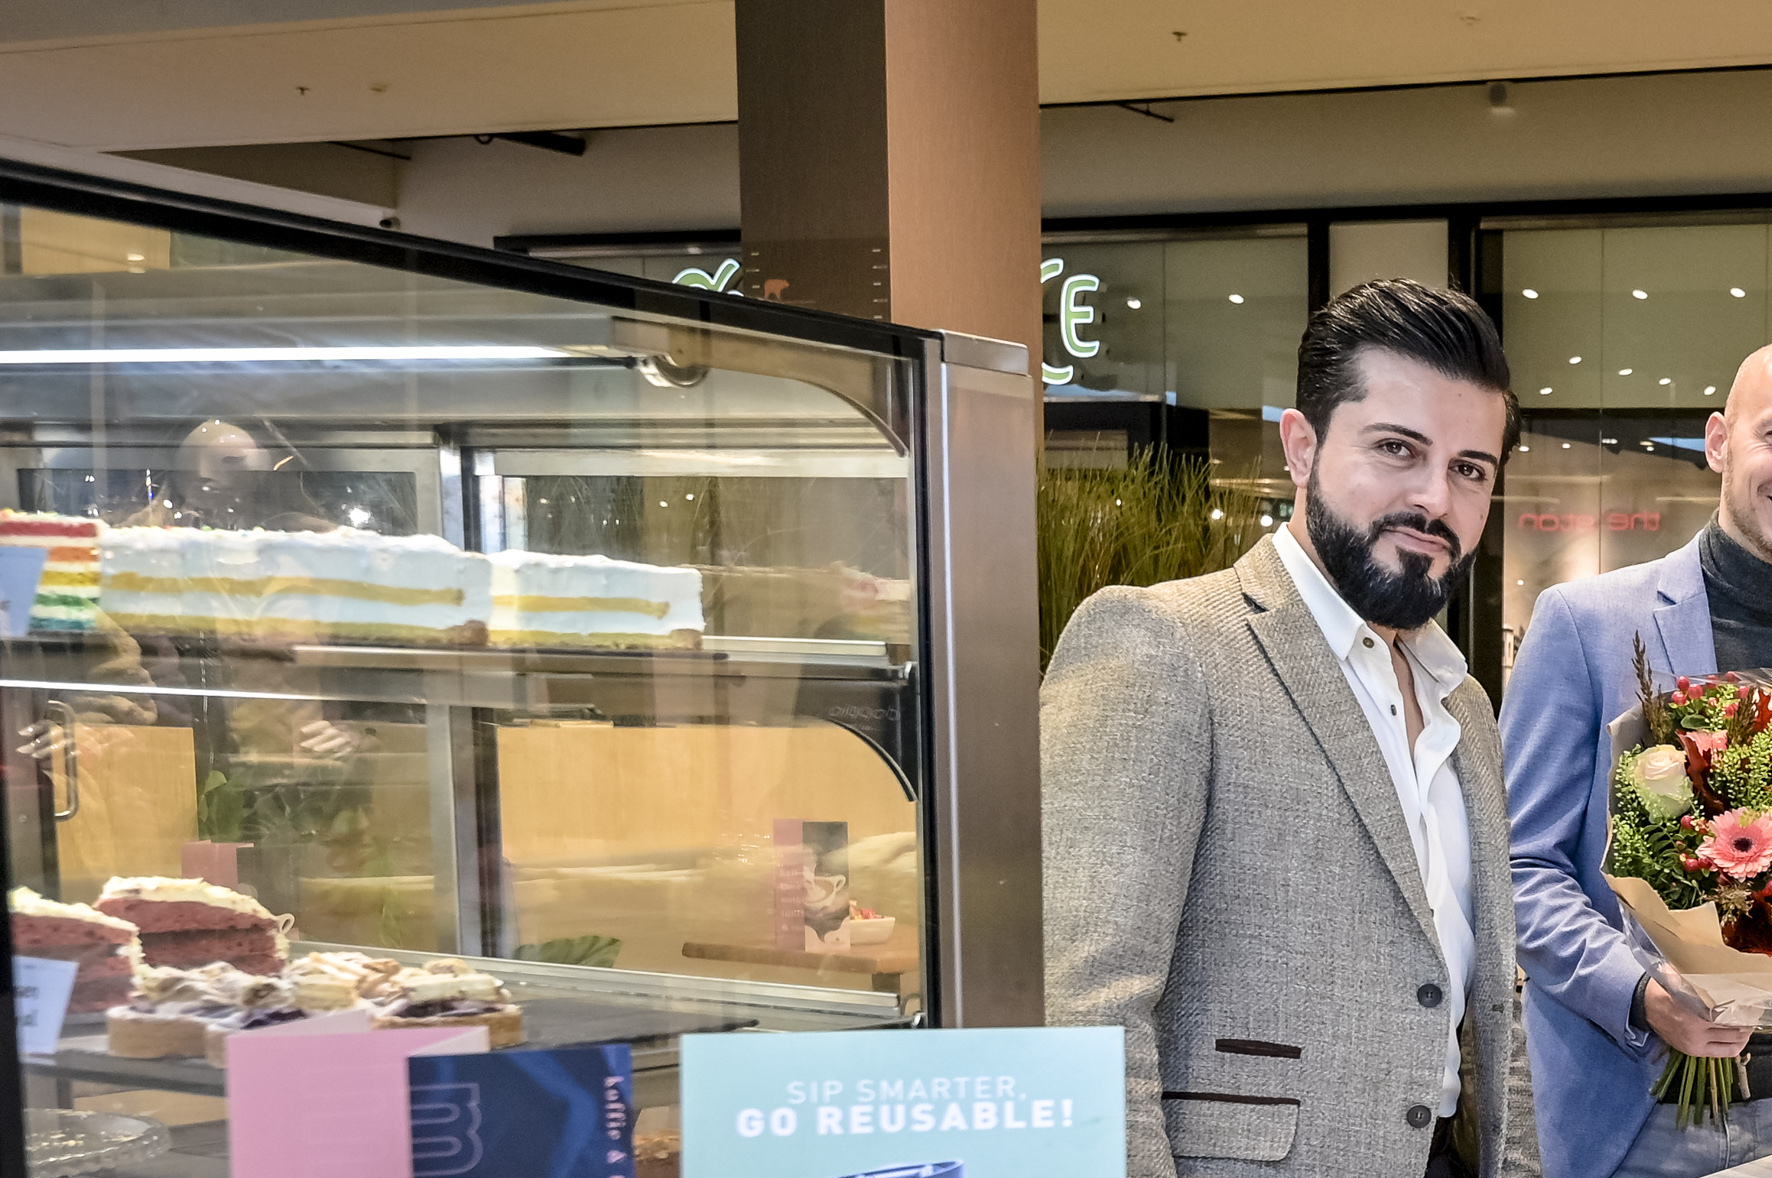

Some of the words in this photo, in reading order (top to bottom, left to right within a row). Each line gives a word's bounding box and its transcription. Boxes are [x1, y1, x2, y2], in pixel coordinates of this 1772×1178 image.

[603, 1075, 627, 1141] koffie
[786, 1080, 844, 1105] SIP
[855, 1075, 1028, 1102] SMARTER,
[735, 1107, 799, 1138] GO
[815, 1098, 1075, 1136] REUSABLE!
